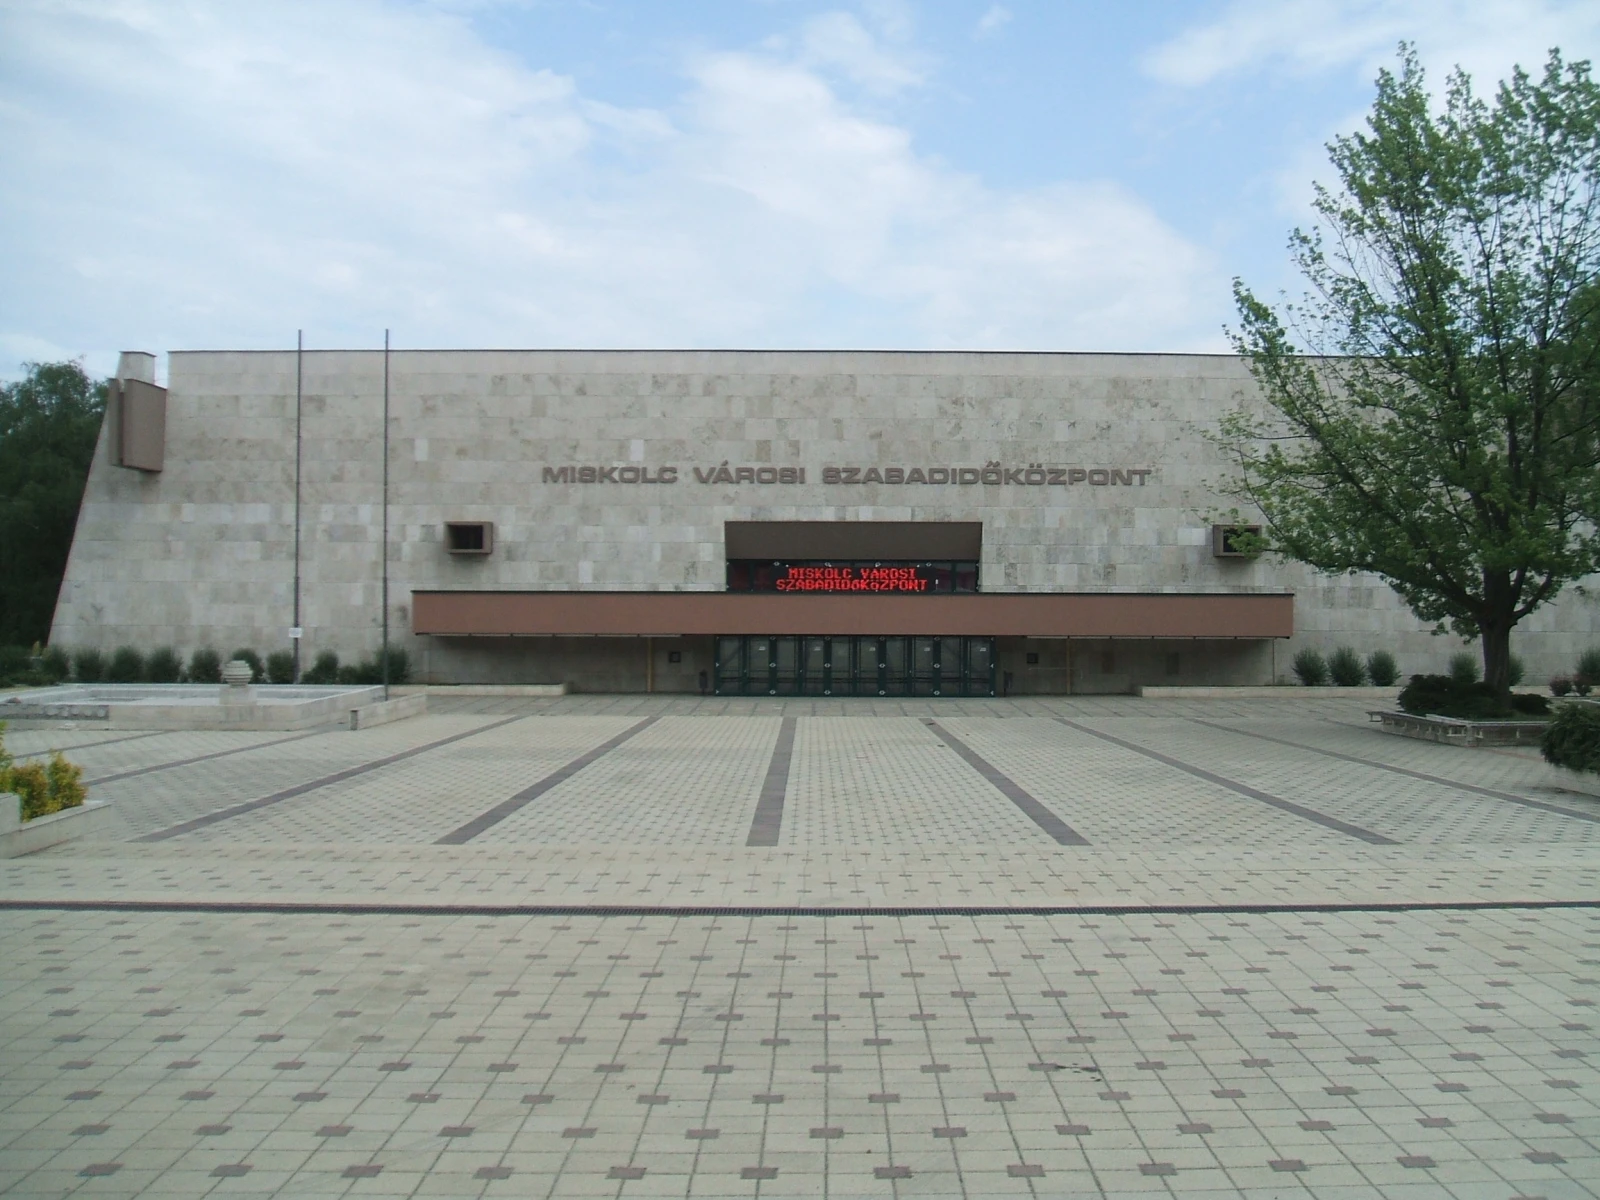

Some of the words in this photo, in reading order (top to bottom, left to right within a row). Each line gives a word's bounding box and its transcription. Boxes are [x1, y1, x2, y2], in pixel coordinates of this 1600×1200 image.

[542, 466, 678, 484] MISKOLC
[692, 460, 806, 484] VÁROSI
[821, 460, 1152, 485] SZABADIDŐKÖZPONT
[787, 567, 853, 579] MISKOLC
